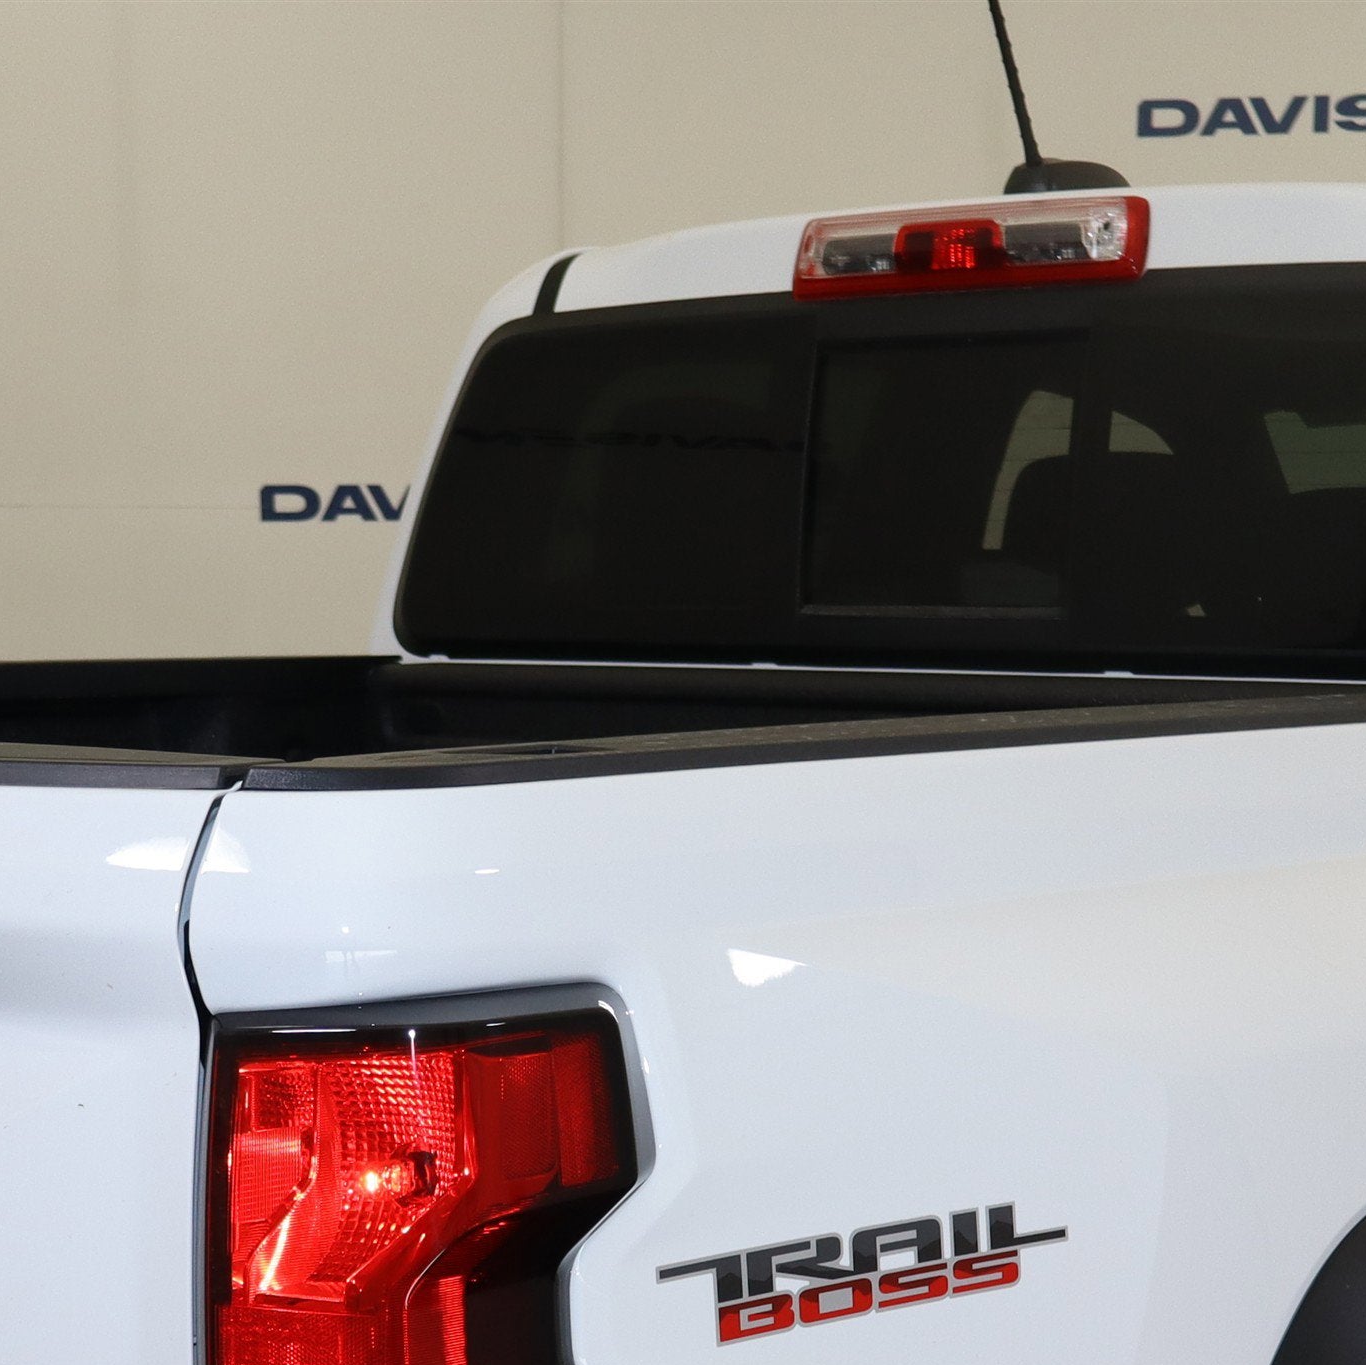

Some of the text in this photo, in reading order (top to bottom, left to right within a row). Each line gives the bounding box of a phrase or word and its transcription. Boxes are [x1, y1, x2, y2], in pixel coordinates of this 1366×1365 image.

[259, 484, 411, 522] DAV
[655, 1200, 1069, 1303] TRAIL
[717, 1249, 1022, 1347] BOSS
